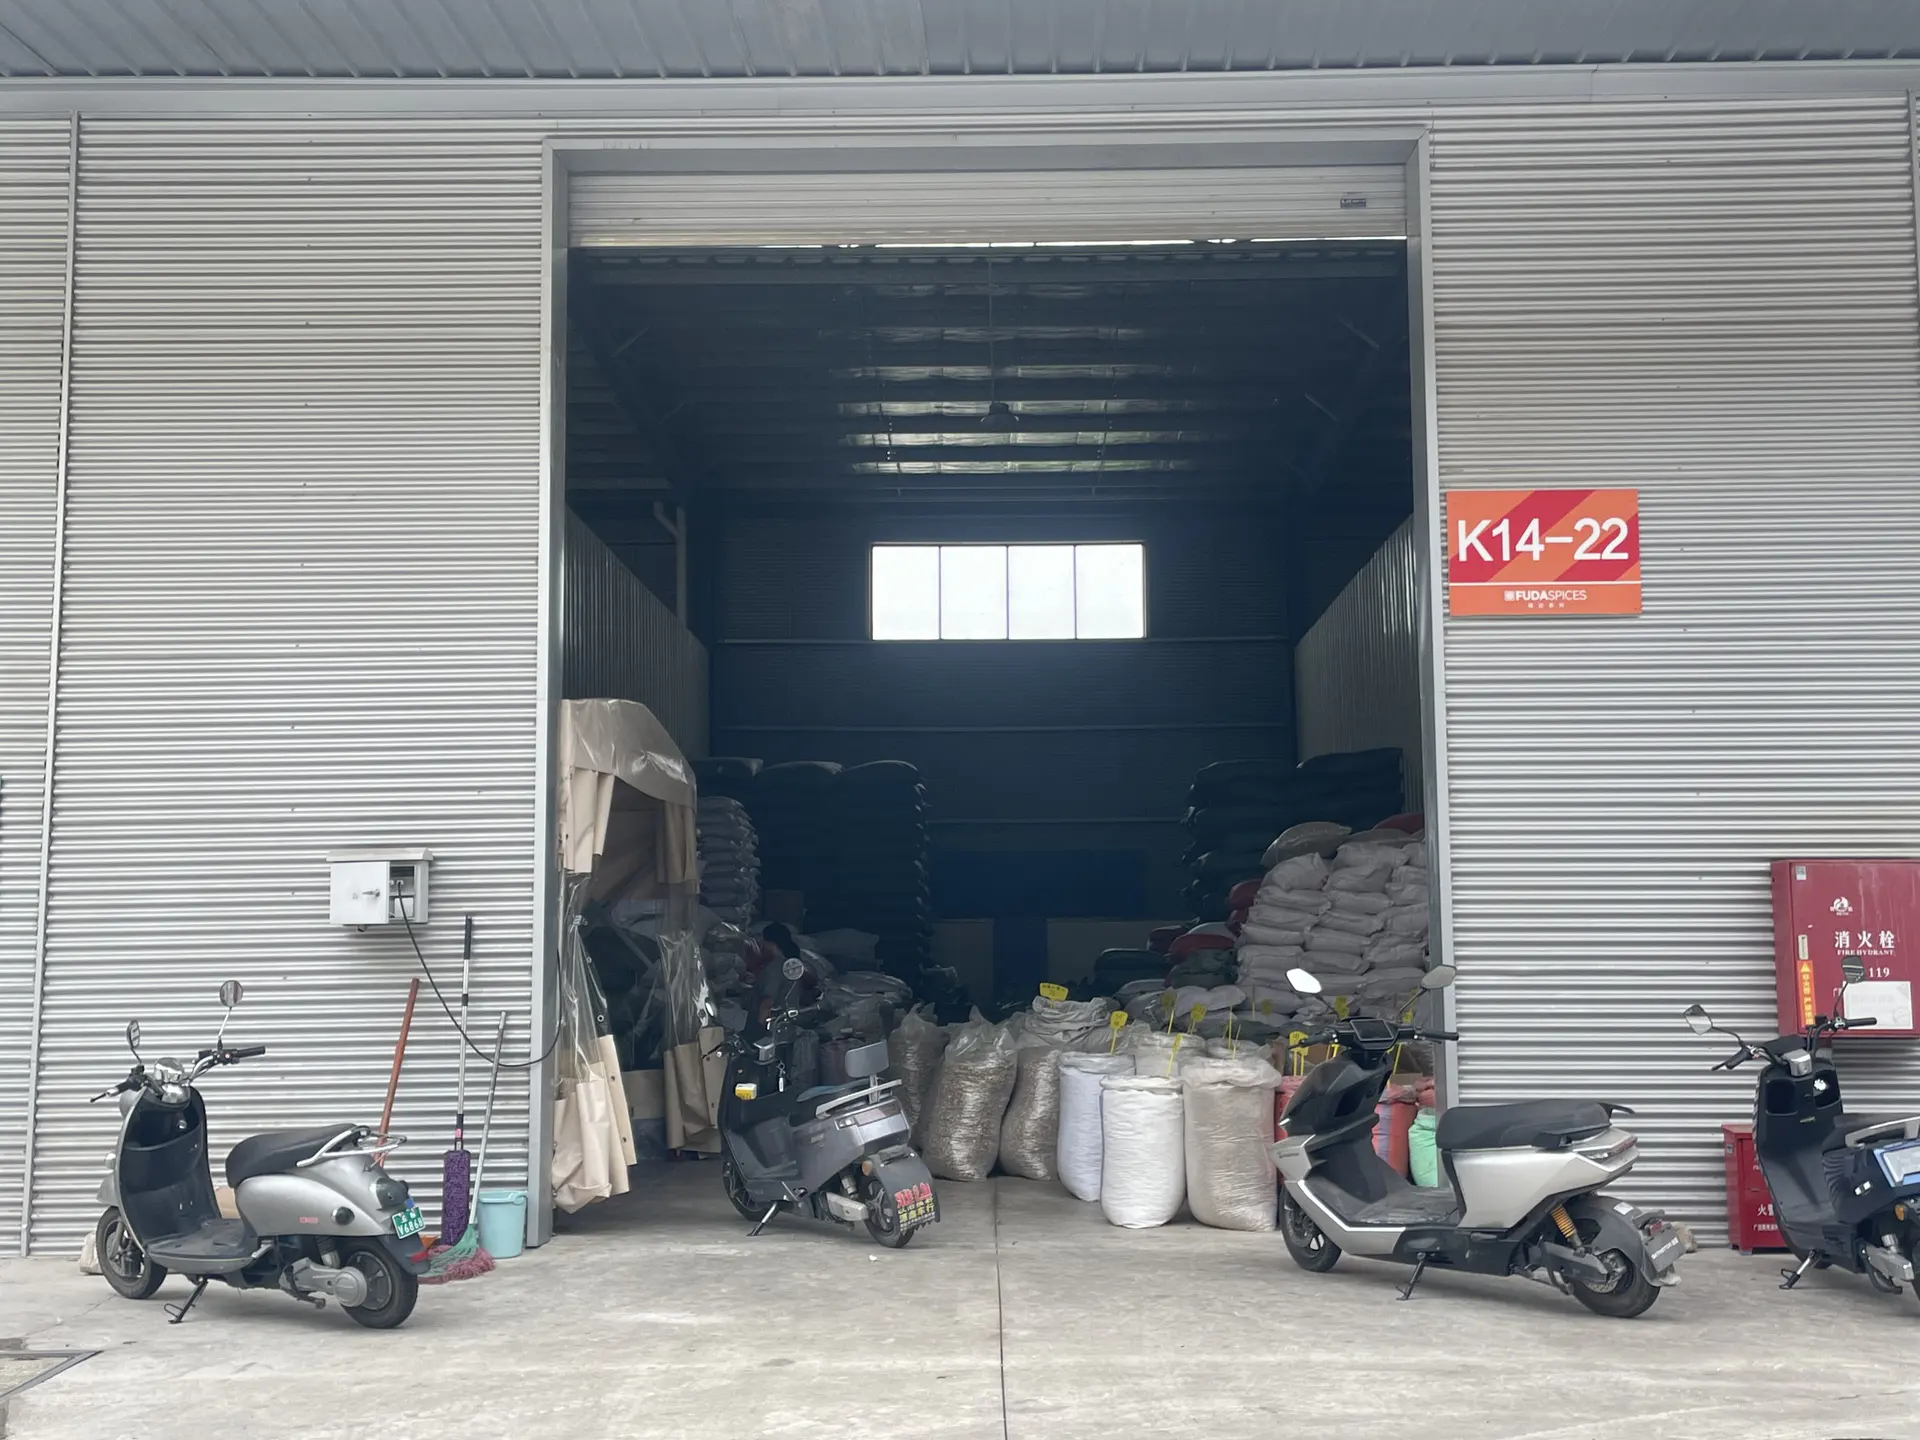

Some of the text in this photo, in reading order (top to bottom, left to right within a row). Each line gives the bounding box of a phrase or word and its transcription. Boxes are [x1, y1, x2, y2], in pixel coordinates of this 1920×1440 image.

[1457, 517, 1629, 562] K14-22
[1834, 930, 1895, 949] 消火栓
[1868, 967, 1890, 978] 119
